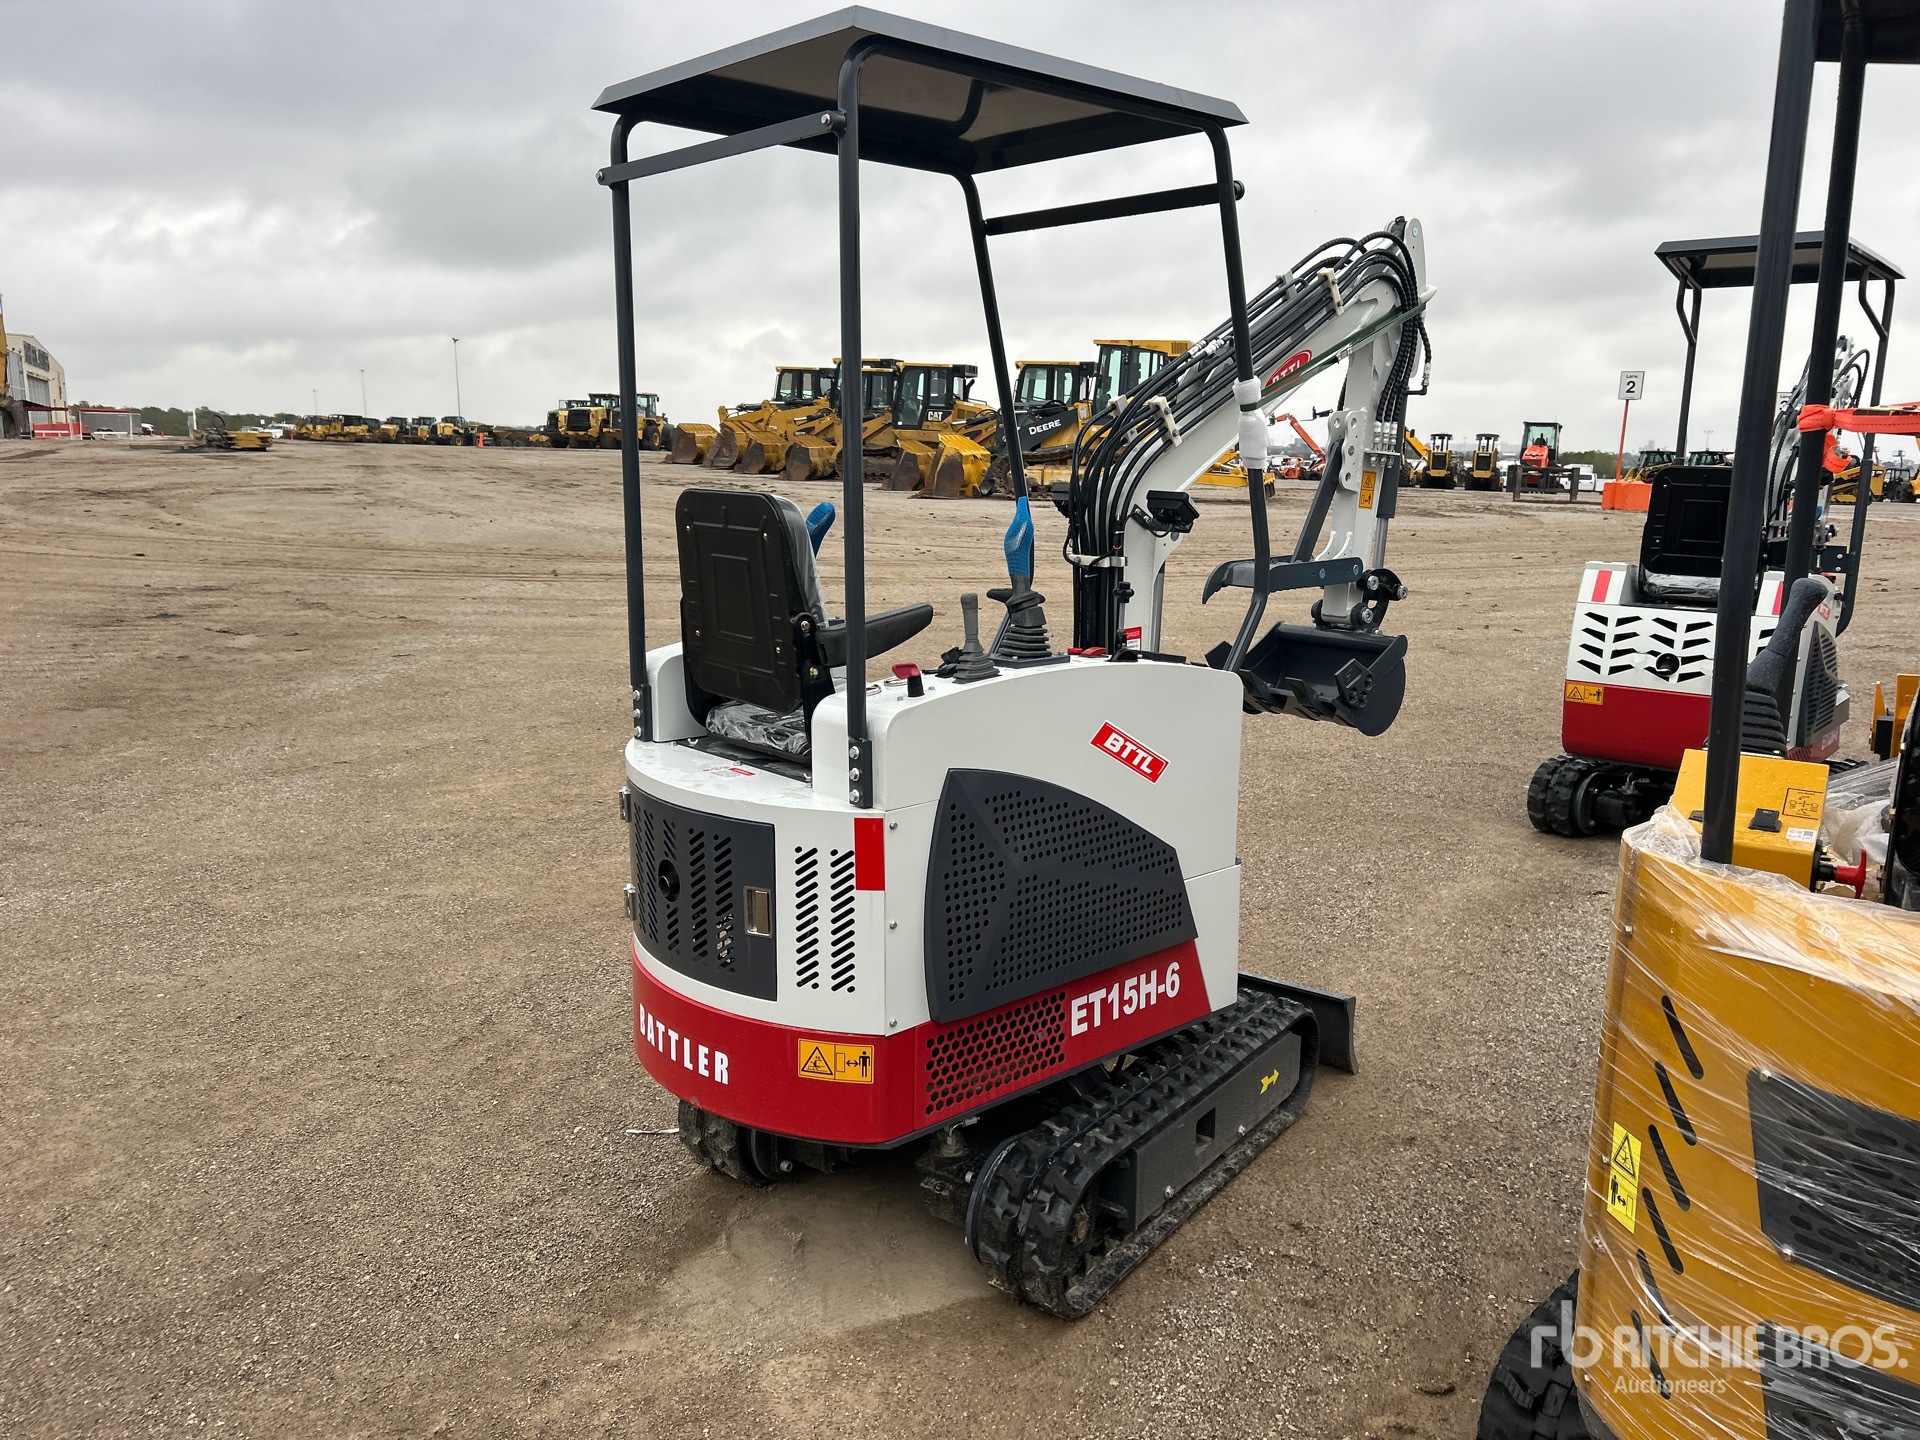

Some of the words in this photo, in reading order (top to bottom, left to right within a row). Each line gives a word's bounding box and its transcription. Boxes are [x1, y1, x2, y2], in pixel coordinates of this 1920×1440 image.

[1625, 380, 1636, 393] 2
[927, 411, 943, 421] CAT
[1028, 419, 1062, 435] DEERE
[1103, 731, 1154, 774] BTTL
[1071, 961, 1180, 1037] ET15H-6
[639, 1002, 729, 1085] BATTLER
